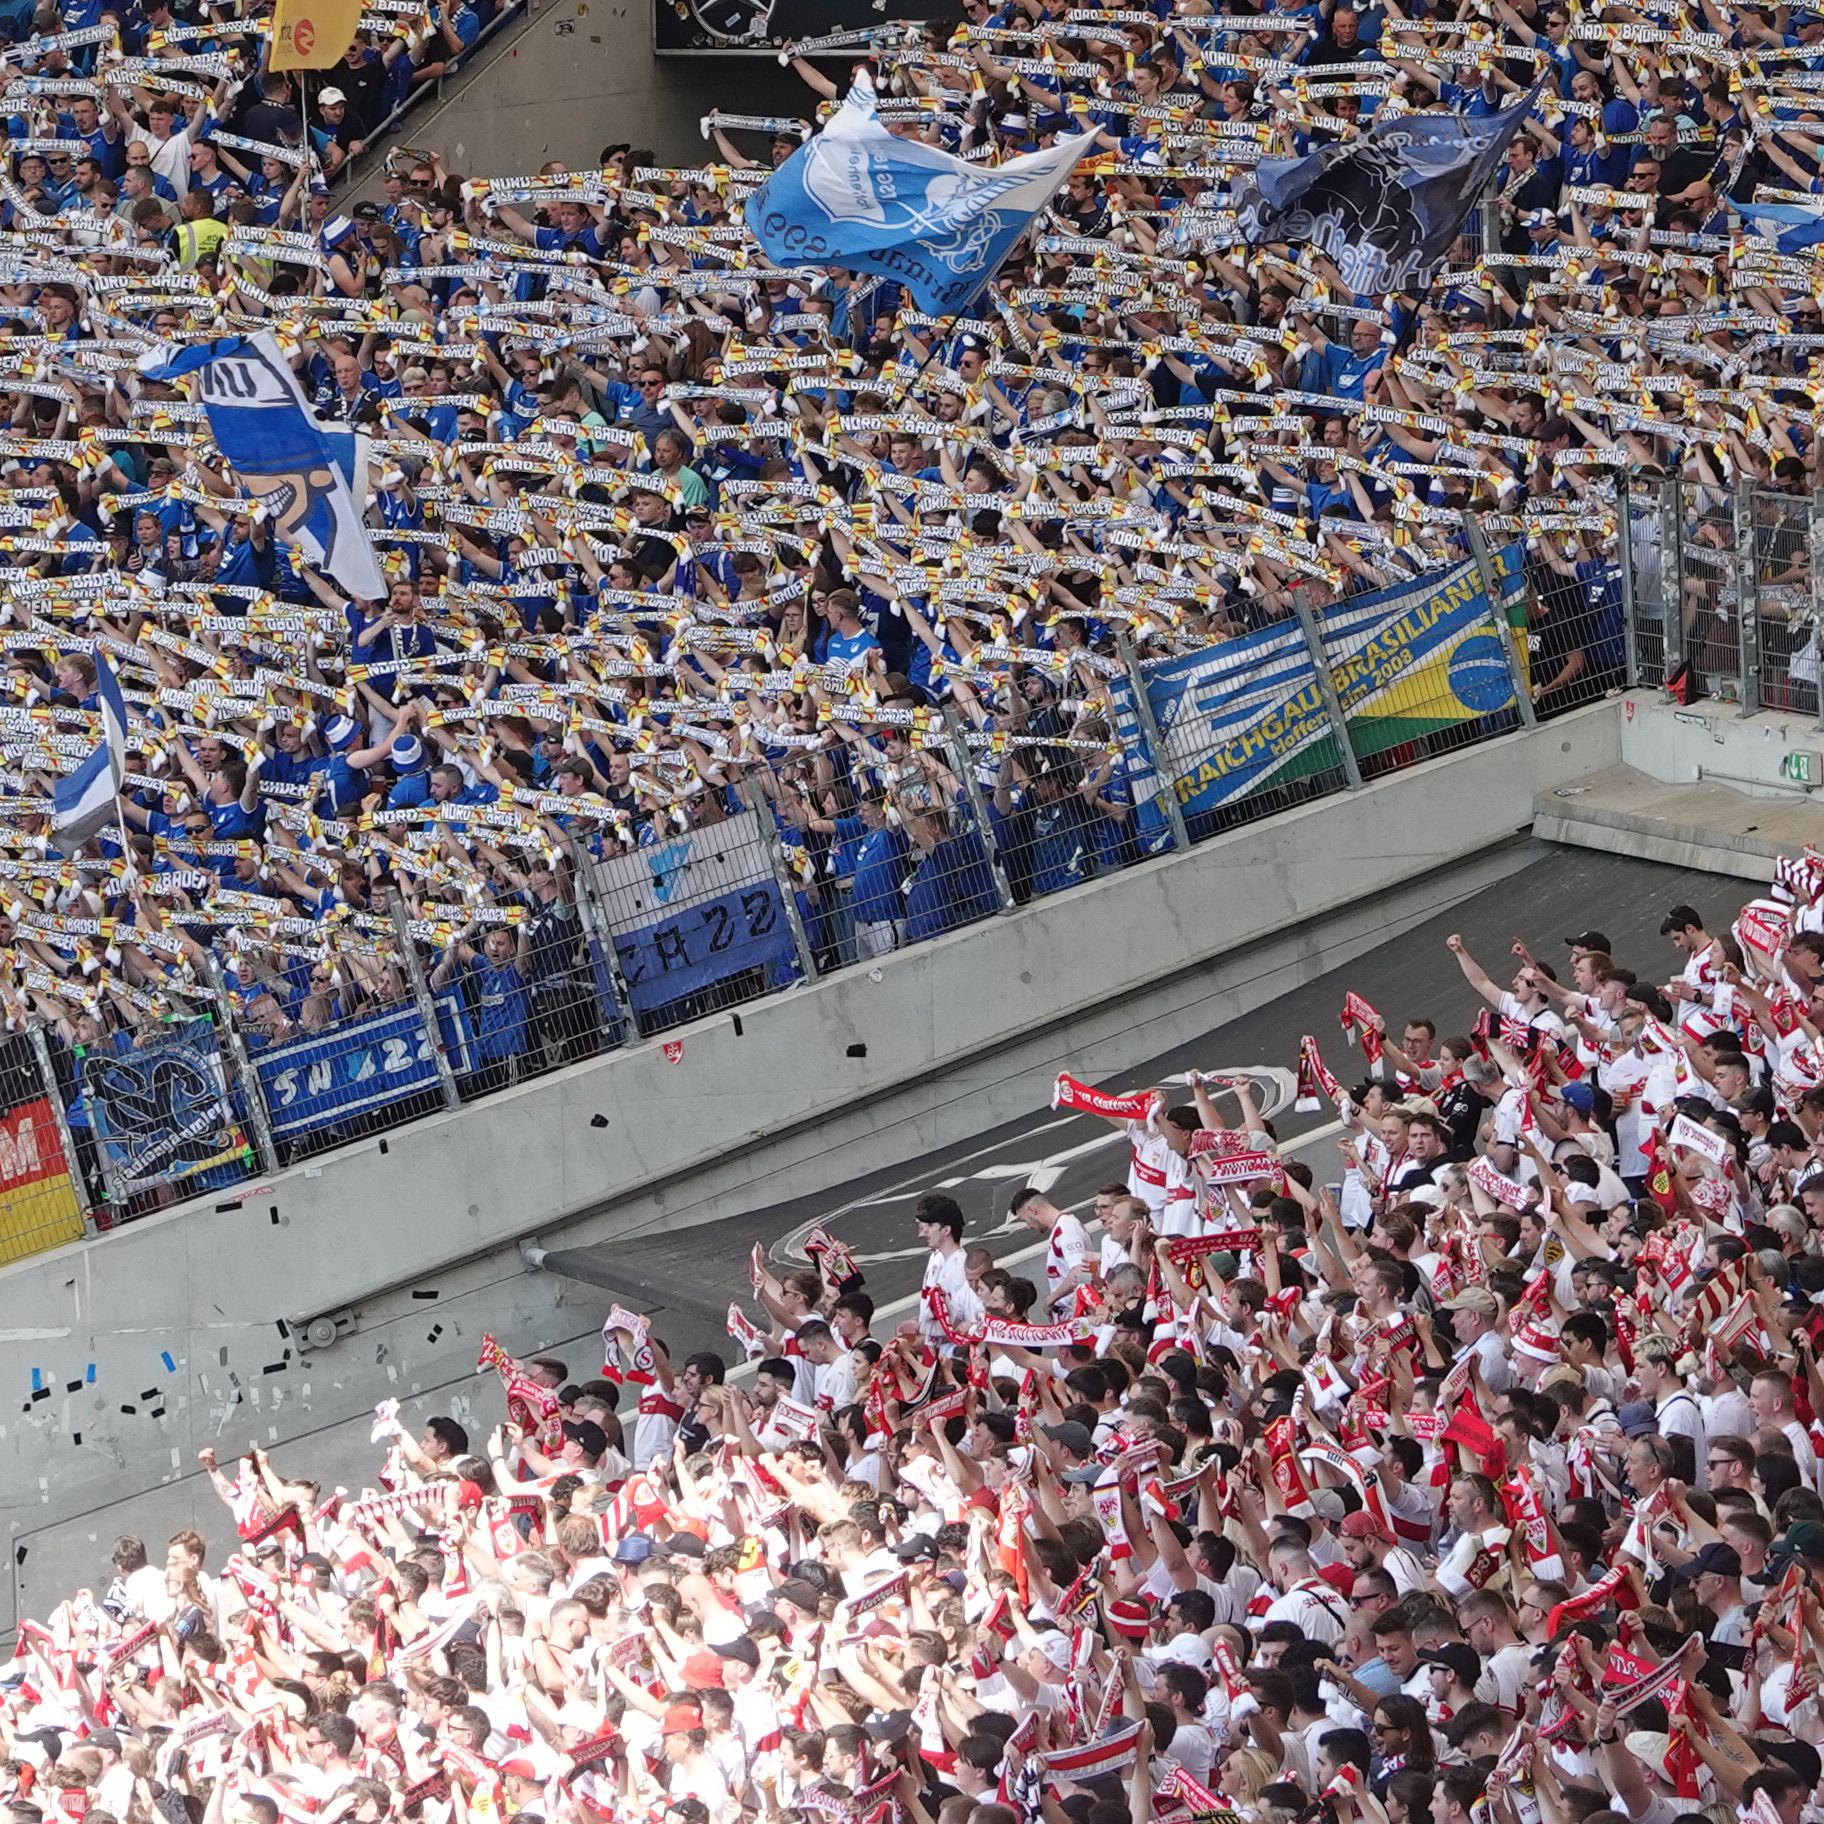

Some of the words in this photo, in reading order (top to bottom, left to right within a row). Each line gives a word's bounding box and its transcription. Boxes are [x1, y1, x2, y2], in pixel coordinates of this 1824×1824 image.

[164, 26, 198, 44] NORD
[217, 19, 258, 34] BADEN
[1184, 18, 1206, 28] TSG
[1225, 17, 1294, 29] HOFFENHEIM
[318, 320, 354, 334] NORD
[377, 321, 422, 334] BADEN
[840, 414, 882, 431] NORD
[904, 418, 955, 435] BADEN
[1330, 554, 1510, 693] BRASILIANER
[1271, 679, 1368, 756] Hoffeneim
[1371, 650, 1415, 689] 2008
[372, 808, 416, 823] NORD
